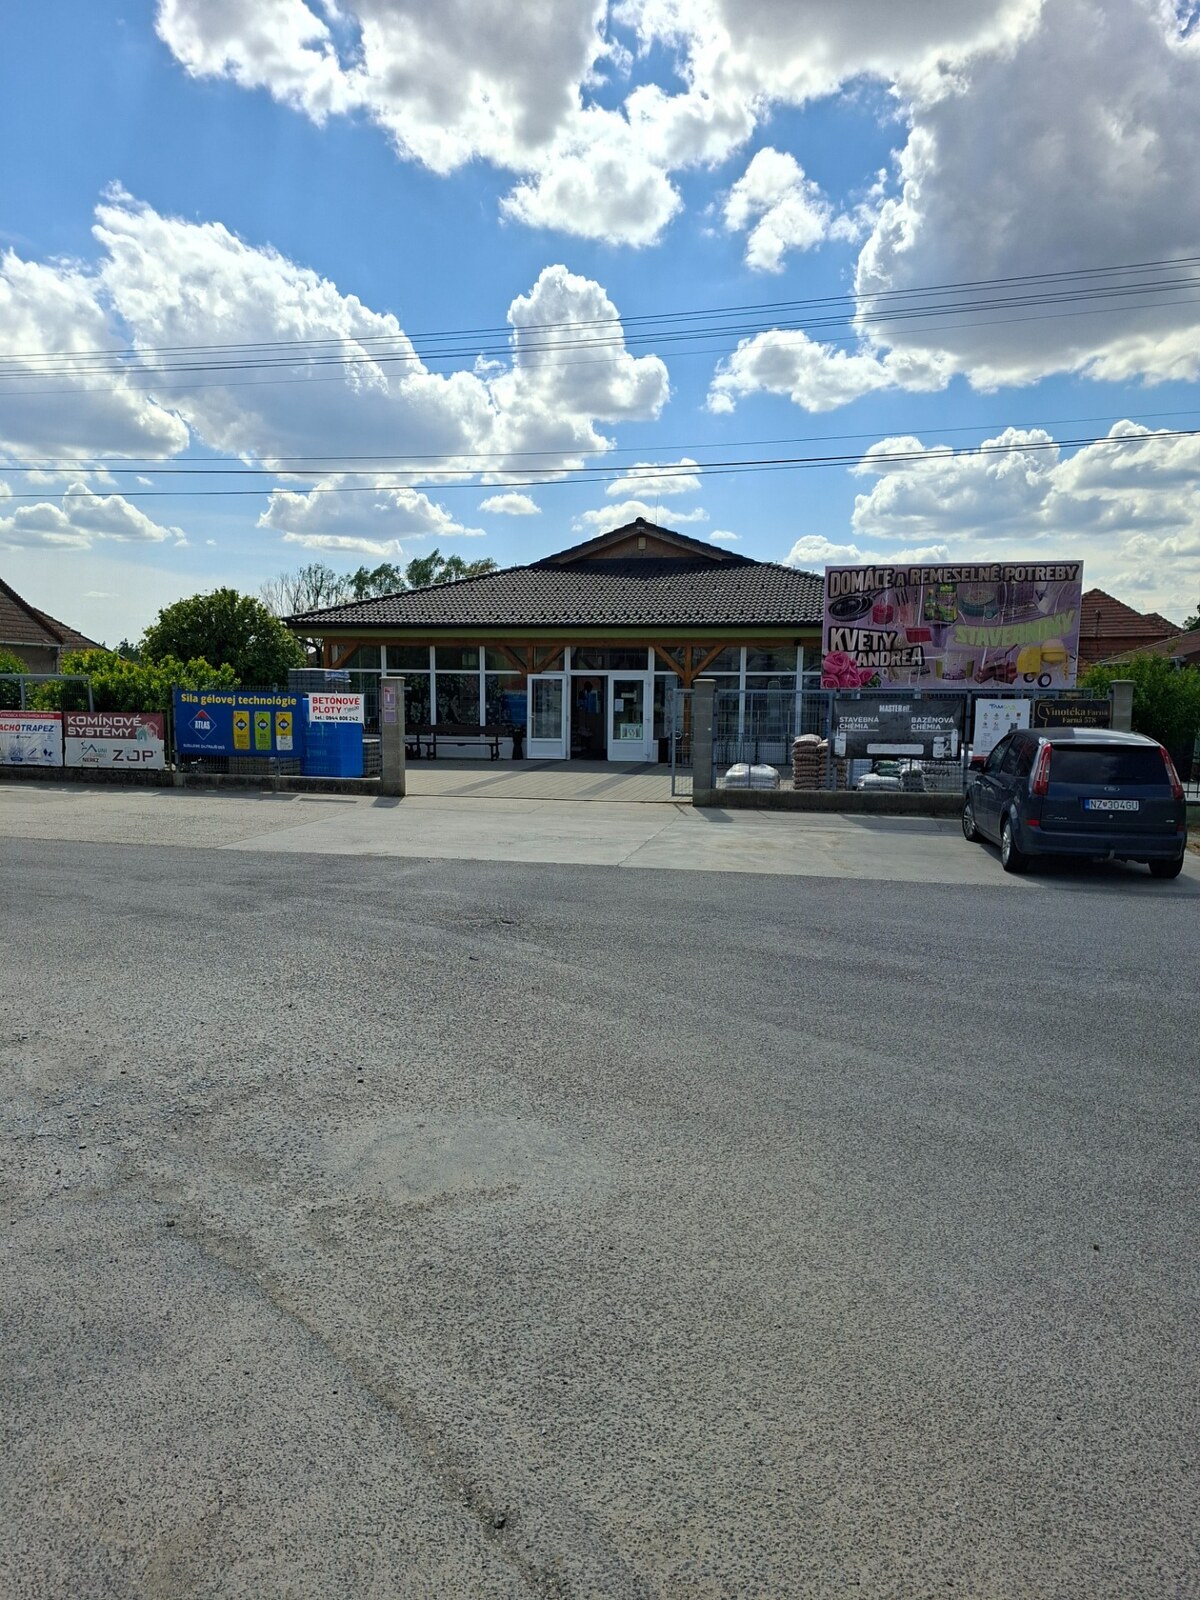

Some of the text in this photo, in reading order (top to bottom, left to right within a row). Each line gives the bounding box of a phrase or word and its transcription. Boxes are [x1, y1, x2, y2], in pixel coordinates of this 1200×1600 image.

[829, 567, 893, 597] DOMÁCE
[910, 565, 1000, 584] REMESELNÉ
[1005, 565, 1078, 582] POTREBY
[830, 628, 896, 651] KVETY
[857, 646, 923, 667] ANDREA
[181, 694, 297, 707] Sila gélovej technológie
[312, 696, 360, 705] BETÓNOVÉ
[312, 706, 342, 714] PLOTY
[1045, 707, 1085, 716] Vinotéka
[67, 714, 142, 726] KOMÍNOVÉ
[839, 715, 879, 723] STAVEBNÁ
[67, 725, 131, 737] SYSTÉMY
[194, 721, 210, 730] ATLAS
